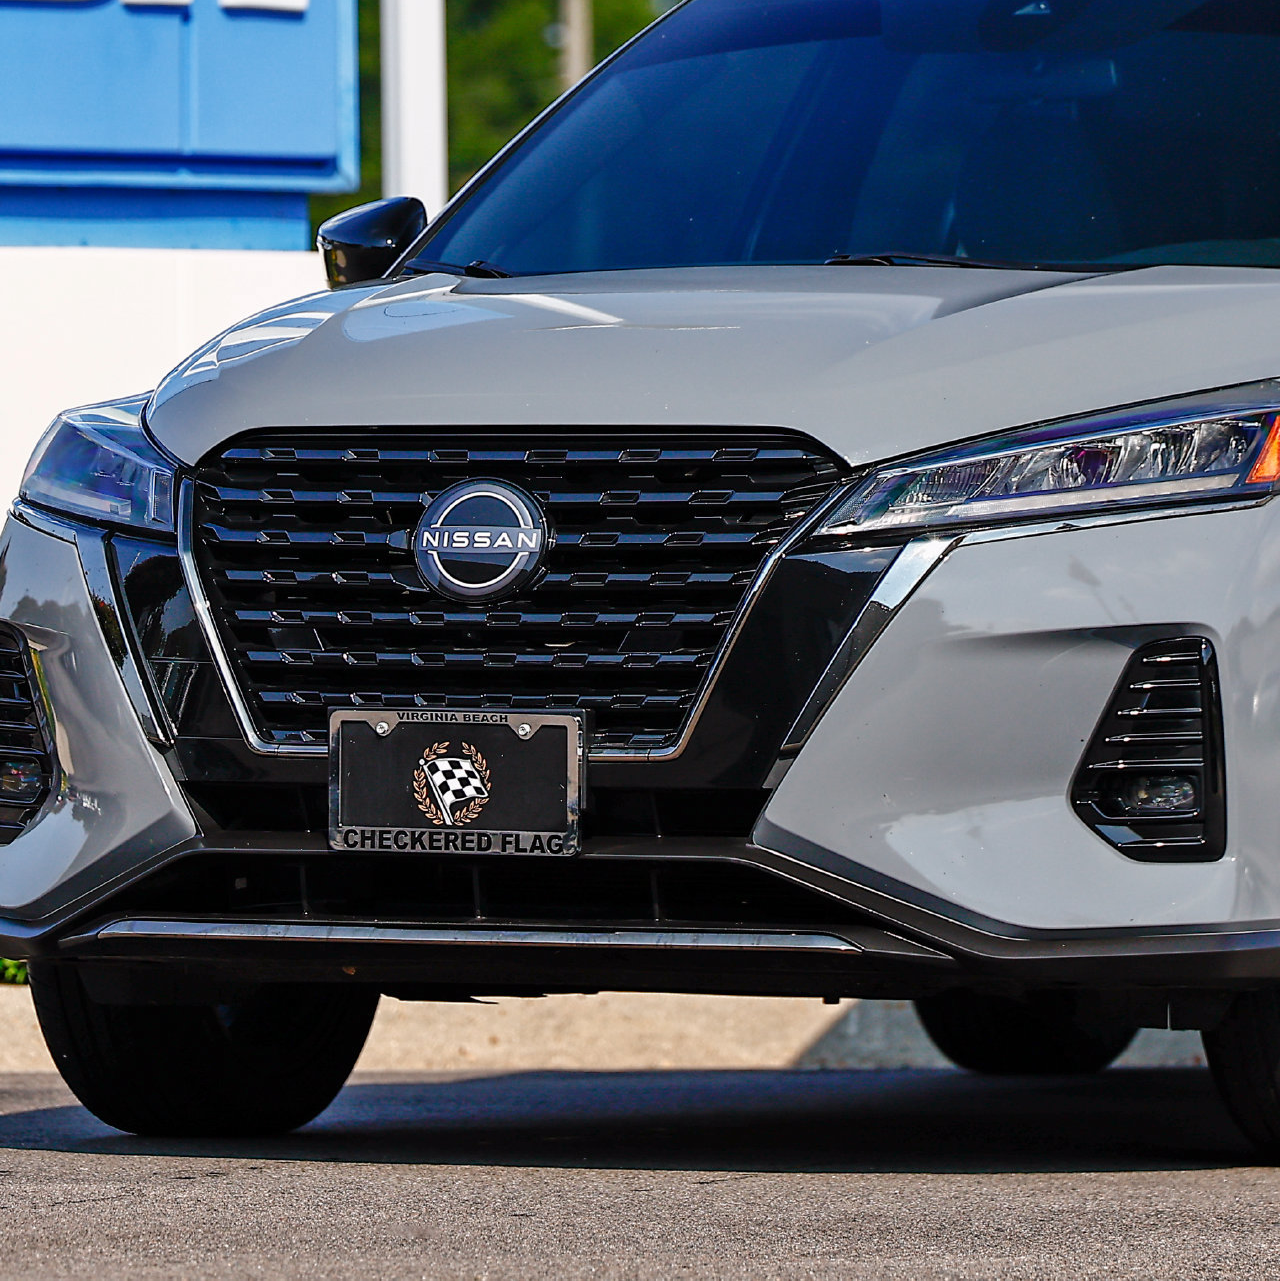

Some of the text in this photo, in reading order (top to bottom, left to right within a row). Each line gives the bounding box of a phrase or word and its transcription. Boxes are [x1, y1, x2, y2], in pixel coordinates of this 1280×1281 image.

[422, 531, 538, 549] NISSAN
[397, 712, 508, 723] VIRGINIA BEACH
[343, 828, 564, 854] CHECKERED FLAG
